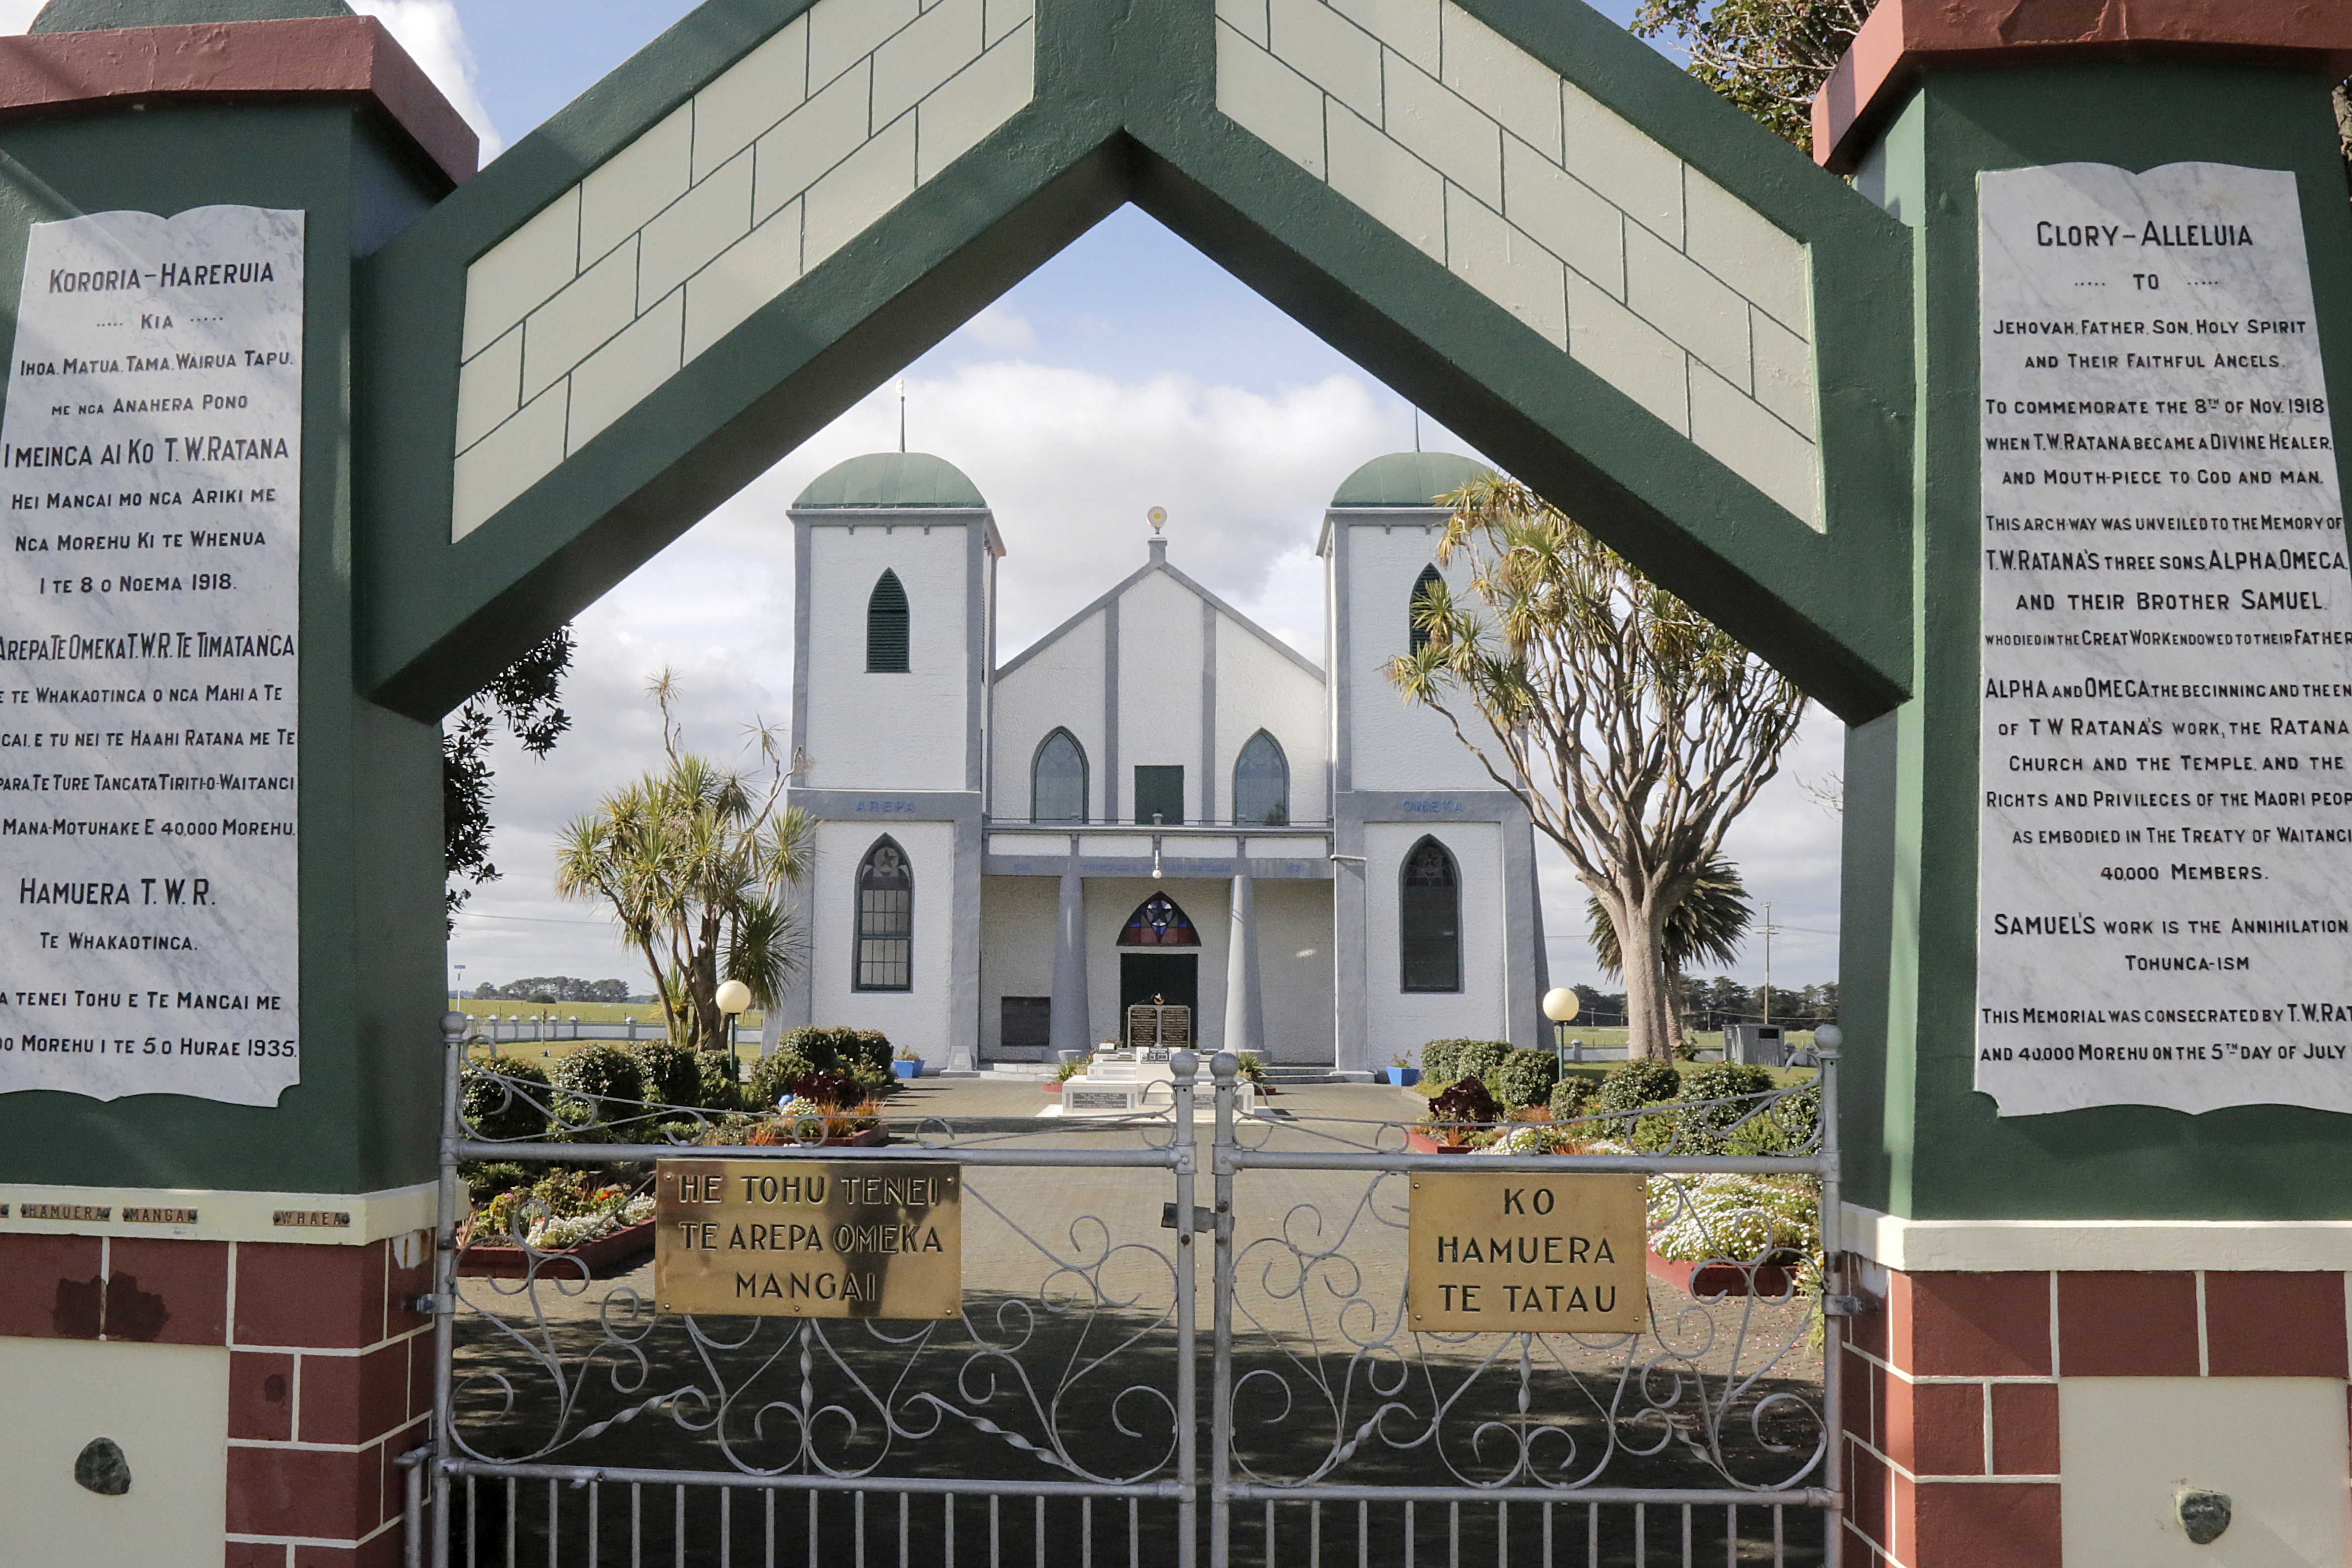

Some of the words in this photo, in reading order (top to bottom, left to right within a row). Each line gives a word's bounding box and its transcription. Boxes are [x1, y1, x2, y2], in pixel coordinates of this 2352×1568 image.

[2133, 274, 2159, 290] TO
[142, 315, 172, 328] KIA
[2196, 320, 2238, 334] HOLY
[2247, 319, 2306, 334] SPIRIT
[176, 354, 236, 369] WAIRUA
[2068, 354, 2118, 368] THEIR
[2127, 353, 2205, 368] FAITHFUL
[2214, 353, 2285, 368] ANGELS.
[79, 404, 104, 414] NGA
[113, 398, 193, 413] ANAHERA
[203, 395, 247, 409] PONO
[2015, 402, 2148, 414] COMMEMORATE
[2155, 402, 2188, 414] THE
[2225, 401, 2244, 414] OF
[2289, 399, 2324, 413] 1918
[1986, 438, 2030, 450] WHEN
[2134, 437, 2194, 450] BECAME
[2210, 433, 2266, 450] DIVINE
[15, 445, 92, 468] MEINGA
[100, 444, 120, 465] AI
[128, 439, 154, 464] KO
[208, 437, 288, 460] RATANA
[2002, 472, 2035, 484] AND
[2044, 470, 2161, 484] MOUTH-PIECE
[2198, 469, 2231, 484] GOD
[2238, 471, 2272, 484] AND
[2280, 471, 2323, 484] MAN.
[12, 494, 39, 510] HEI
[47, 493, 111, 509] MANGAI
[150, 492, 182, 505] NGA
[192, 488, 242, 504] ARIKI
[251, 489, 275, 502] ME
[1986, 515, 2021, 531] THIS
[2101, 518, 2132, 531] WAS
[2136, 518, 2208, 530] UNVEILED
[2232, 518, 2258, 530] THE
[2261, 515, 2324, 530] MEMORY
[2327, 517, 2342, 530] OF
[15, 536, 48, 552] NGA
[57, 535, 130, 551] MOREHU
[138, 532, 154, 548] KI
[162, 534, 183, 548] TE
[190, 530, 265, 547] WHENUA
[2104, 556, 2155, 570] THREE
[53, 580, 72, 594] TE
[120, 576, 182, 592] NOEMA
[192, 573, 236, 591] 1918.
[2016, 594, 2054, 610] AND
[2068, 594, 2124, 610] THEIR
[2137, 592, 2229, 610] BROTHER
[69, 635, 126, 659] OMEKA
[176, 632, 192, 658] TE
[197, 632, 294, 658] TIMATANGA
[1985, 635, 2011, 645] WHO
[2057, 635, 2079, 645] THE
[2082, 630, 2128, 645] GREAT
[2129, 630, 2170, 645] WORK
[2172, 634, 2232, 645] ENDOWED
[2254, 634, 2292, 644] THEIR
[11, 691, 29, 704] TE
[36, 687, 146, 703] WHAKAOTINGA
[169, 689, 198, 702] NGA
[206, 685, 244, 701] MAHI
[264, 684, 282, 701] TE
[1986, 678, 2048, 698] ALPHA
[2052, 686, 2082, 698] AND
[2182, 685, 2266, 698] BEGINNING
[1998, 724, 2018, 735] OF
[2229, 722, 2261, 735] THE
[2271, 718, 2350, 735] RATANA
[75, 733, 99, 746] NEI
[131, 730, 179, 746] HAAHI
[185, 729, 243, 746] RATANA
[250, 732, 270, 745] ME
[277, 728, 295, 745] TE
[2010, 756, 2082, 771] CHURCH
[2309, 757, 2344, 770] THE
[53, 774, 89, 790] TURE
[94, 774, 157, 791] TANGATA
[855, 801, 916, 812] AREPA
[1402, 800, 1463, 812] OMEKA
[1987, 792, 2048, 807] RIGHTS
[2094, 791, 2191, 806] PRIVILEGES
[2220, 793, 2248, 806] THE
[2255, 791, 2305, 806] MAORI
[223, 819, 295, 836] MOREHU.
[2039, 830, 2120, 844] EMBODIED
[2147, 827, 2176, 843] THE
[2182, 827, 2245, 843] TREATY
[2276, 827, 2352, 843] WAITANGI
[2171, 864, 2268, 880] MEMBERS.
[20, 878, 130, 905] HAMUERA
[1994, 912, 2095, 935] SAMUEL'S
[2104, 922, 2153, 934] WORK
[2188, 921, 2221, 933] THE
[2232, 918, 2348, 933] ANNIHILATION
[40, 932, 59, 948] TE
[69, 932, 197, 950] WHAKAOTINGA.
[2125, 955, 2249, 970] TOHUNGA-ISM
[16, 992, 66, 1006] TENEI
[75, 990, 120, 1007] TOHU
[177, 992, 248, 1009] MANGAI
[257, 996, 281, 1010] ME
[1982, 1008, 2019, 1023] THIS
[2023, 1008, 2106, 1023] MEMORIAL
[2109, 1010, 2141, 1022] WAS
[2145, 1009, 2259, 1022] CONSECRATED
[22, 1035, 93, 1053] MOREHU
[114, 1040, 135, 1053] TE
[180, 1038, 240, 1056] HURAE
[248, 1039, 296, 1057] 1935.
[1981, 1048, 2013, 1061] AND
[2078, 1044, 2148, 1060] MOREHU
[2153, 1046, 2172, 1060] ON
[2176, 1046, 2206, 1060] THE
[2241, 1046, 2272, 1059] DAY
[2278, 1045, 2296, 1059] OF
[2303, 1043, 2346, 1059] JULY
[678, 1175, 723, 1204] HE
[740, 1176, 825, 1204] TOHU
[841, 1177, 939, 1206] TENEI
[1504, 1188, 1555, 1215] KO
[678, 1222, 719, 1250] TE
[729, 1224, 823, 1252] AREPA
[833, 1224, 943, 1253] OMEKA
[1438, 1237, 1615, 1264] HAMUERA
[736, 1273, 876, 1301] MANGAI
[1439, 1286, 1480, 1312] TE
[1503, 1286, 1615, 1312] TATAU
